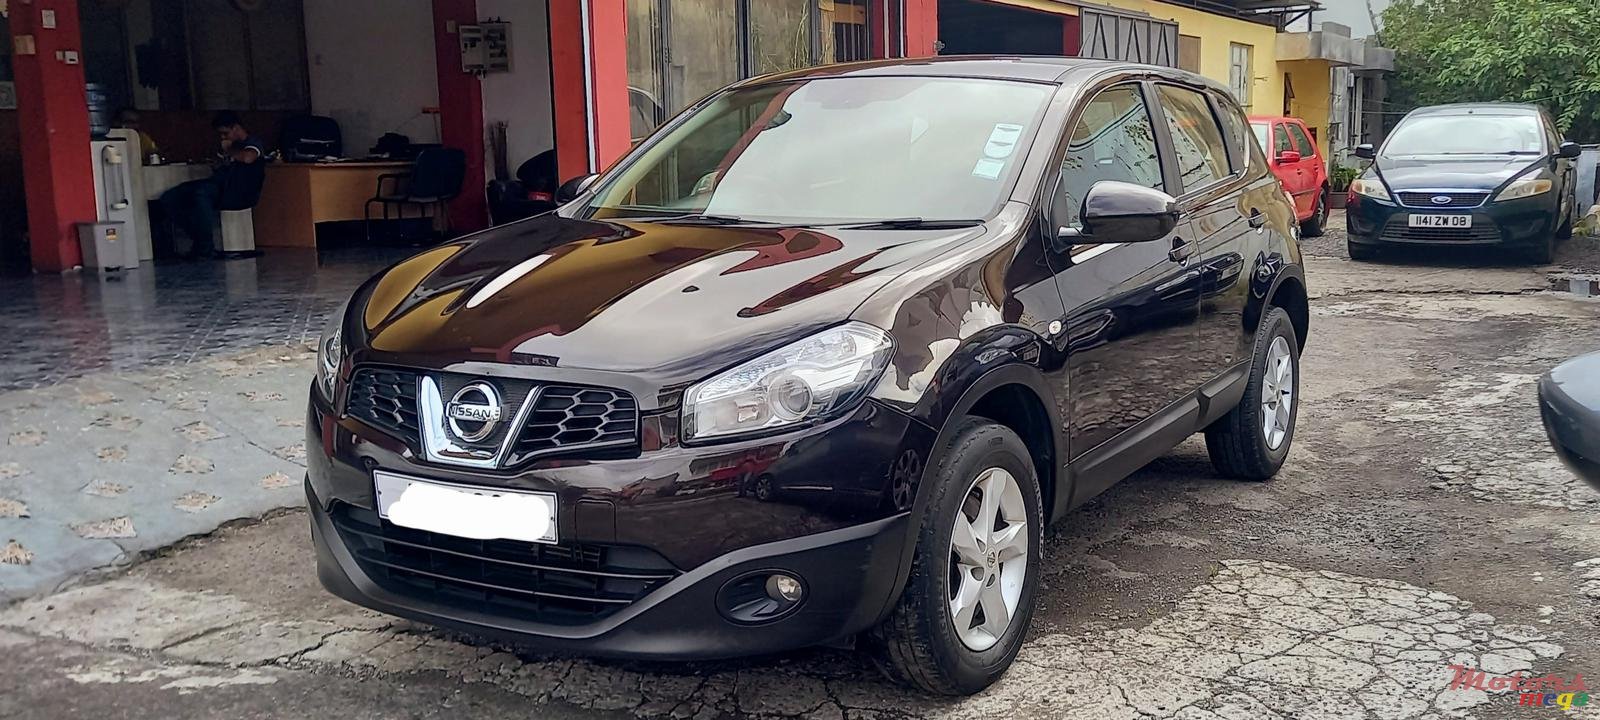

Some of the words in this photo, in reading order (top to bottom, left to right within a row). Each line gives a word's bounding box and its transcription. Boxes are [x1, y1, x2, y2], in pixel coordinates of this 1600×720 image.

[1415, 215, 1432, 226] 1141
[1434, 216, 1449, 226] ZW
[1452, 216, 1467, 226] 08
[449, 404, 491, 418] NISSAN
